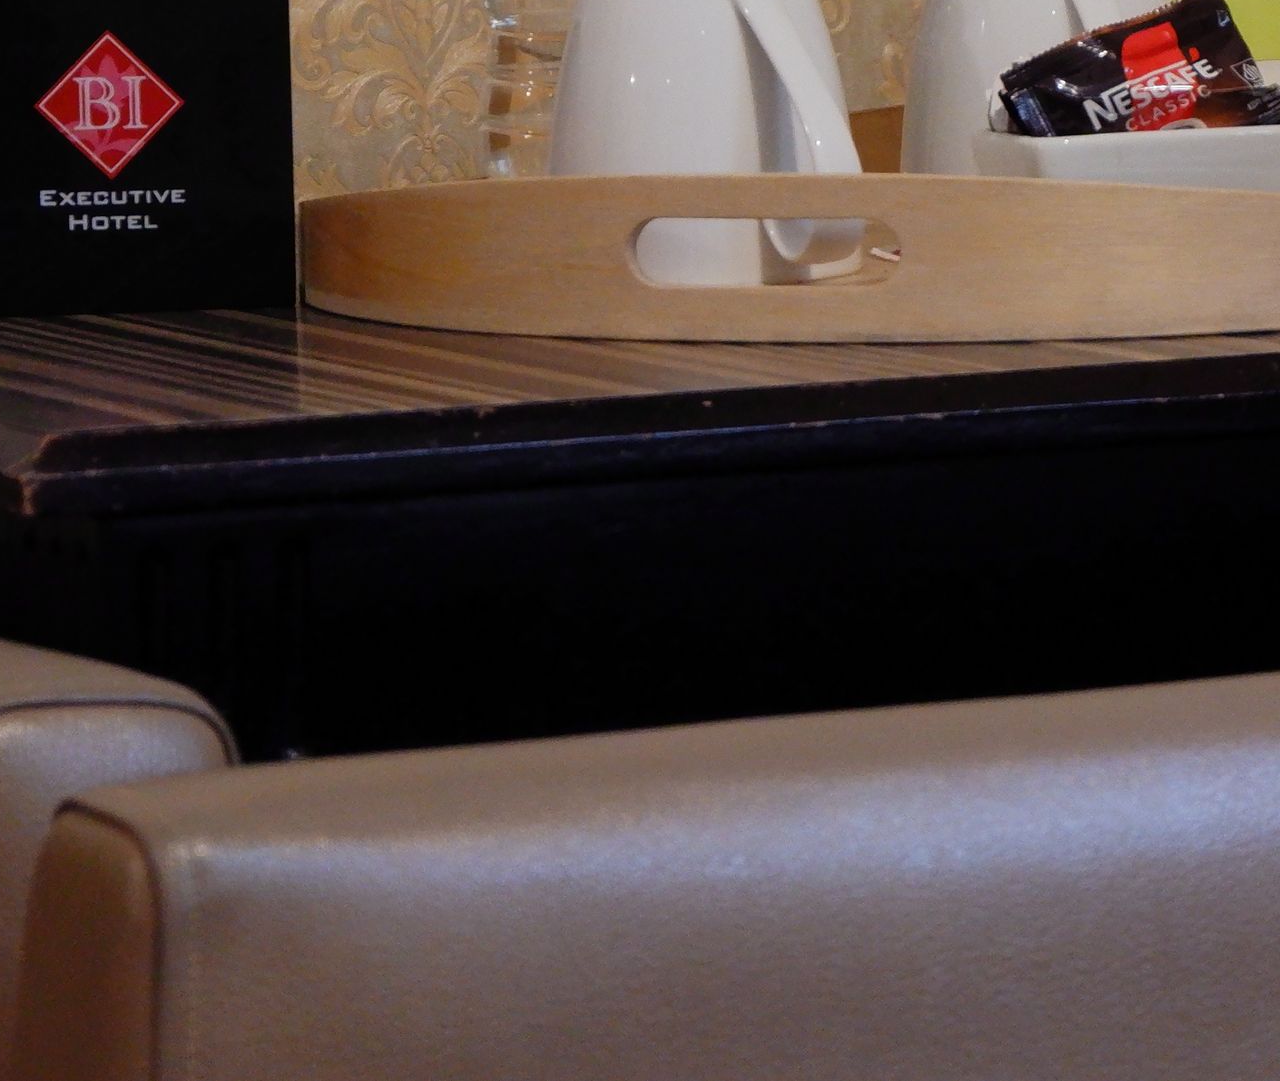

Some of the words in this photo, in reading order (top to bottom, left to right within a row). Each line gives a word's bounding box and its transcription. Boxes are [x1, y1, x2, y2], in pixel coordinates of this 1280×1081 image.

[72, 75, 149, 131] BI
[1125, 84, 1212, 132] CLASSIC
[39, 189, 187, 207] EXECUTIVE
[68, 214, 159, 231] HOTEL
